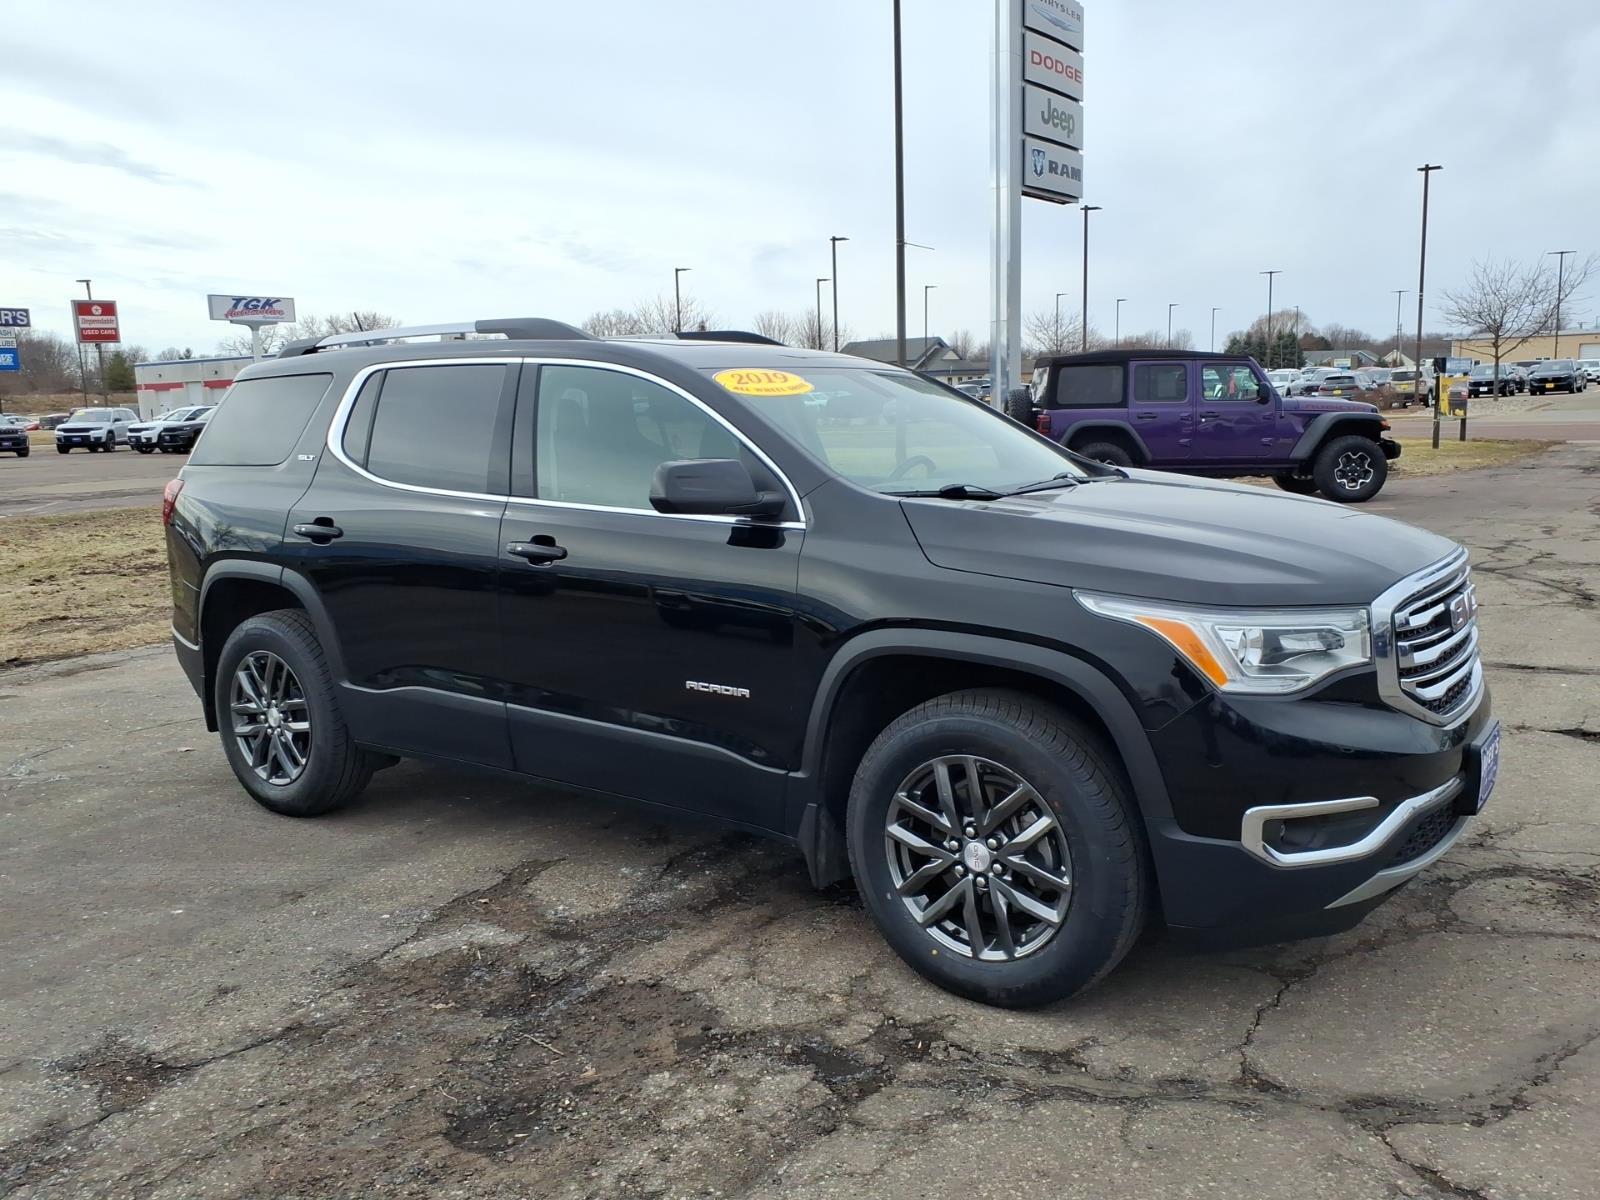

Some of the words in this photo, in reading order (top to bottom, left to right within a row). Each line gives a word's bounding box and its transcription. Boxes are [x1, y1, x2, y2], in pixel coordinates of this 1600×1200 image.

[1040, 0, 1081, 22] RYSLER
[1031, 50, 1082, 84] DODGE
[1041, 98, 1075, 138] Jeep
[1048, 160, 1082, 182] RAM
[232, 297, 281, 310] TGK
[0, 310, 28, 325] R'S
[731, 373, 788, 384] 2019
[685, 680, 750, 698] ACADIA
